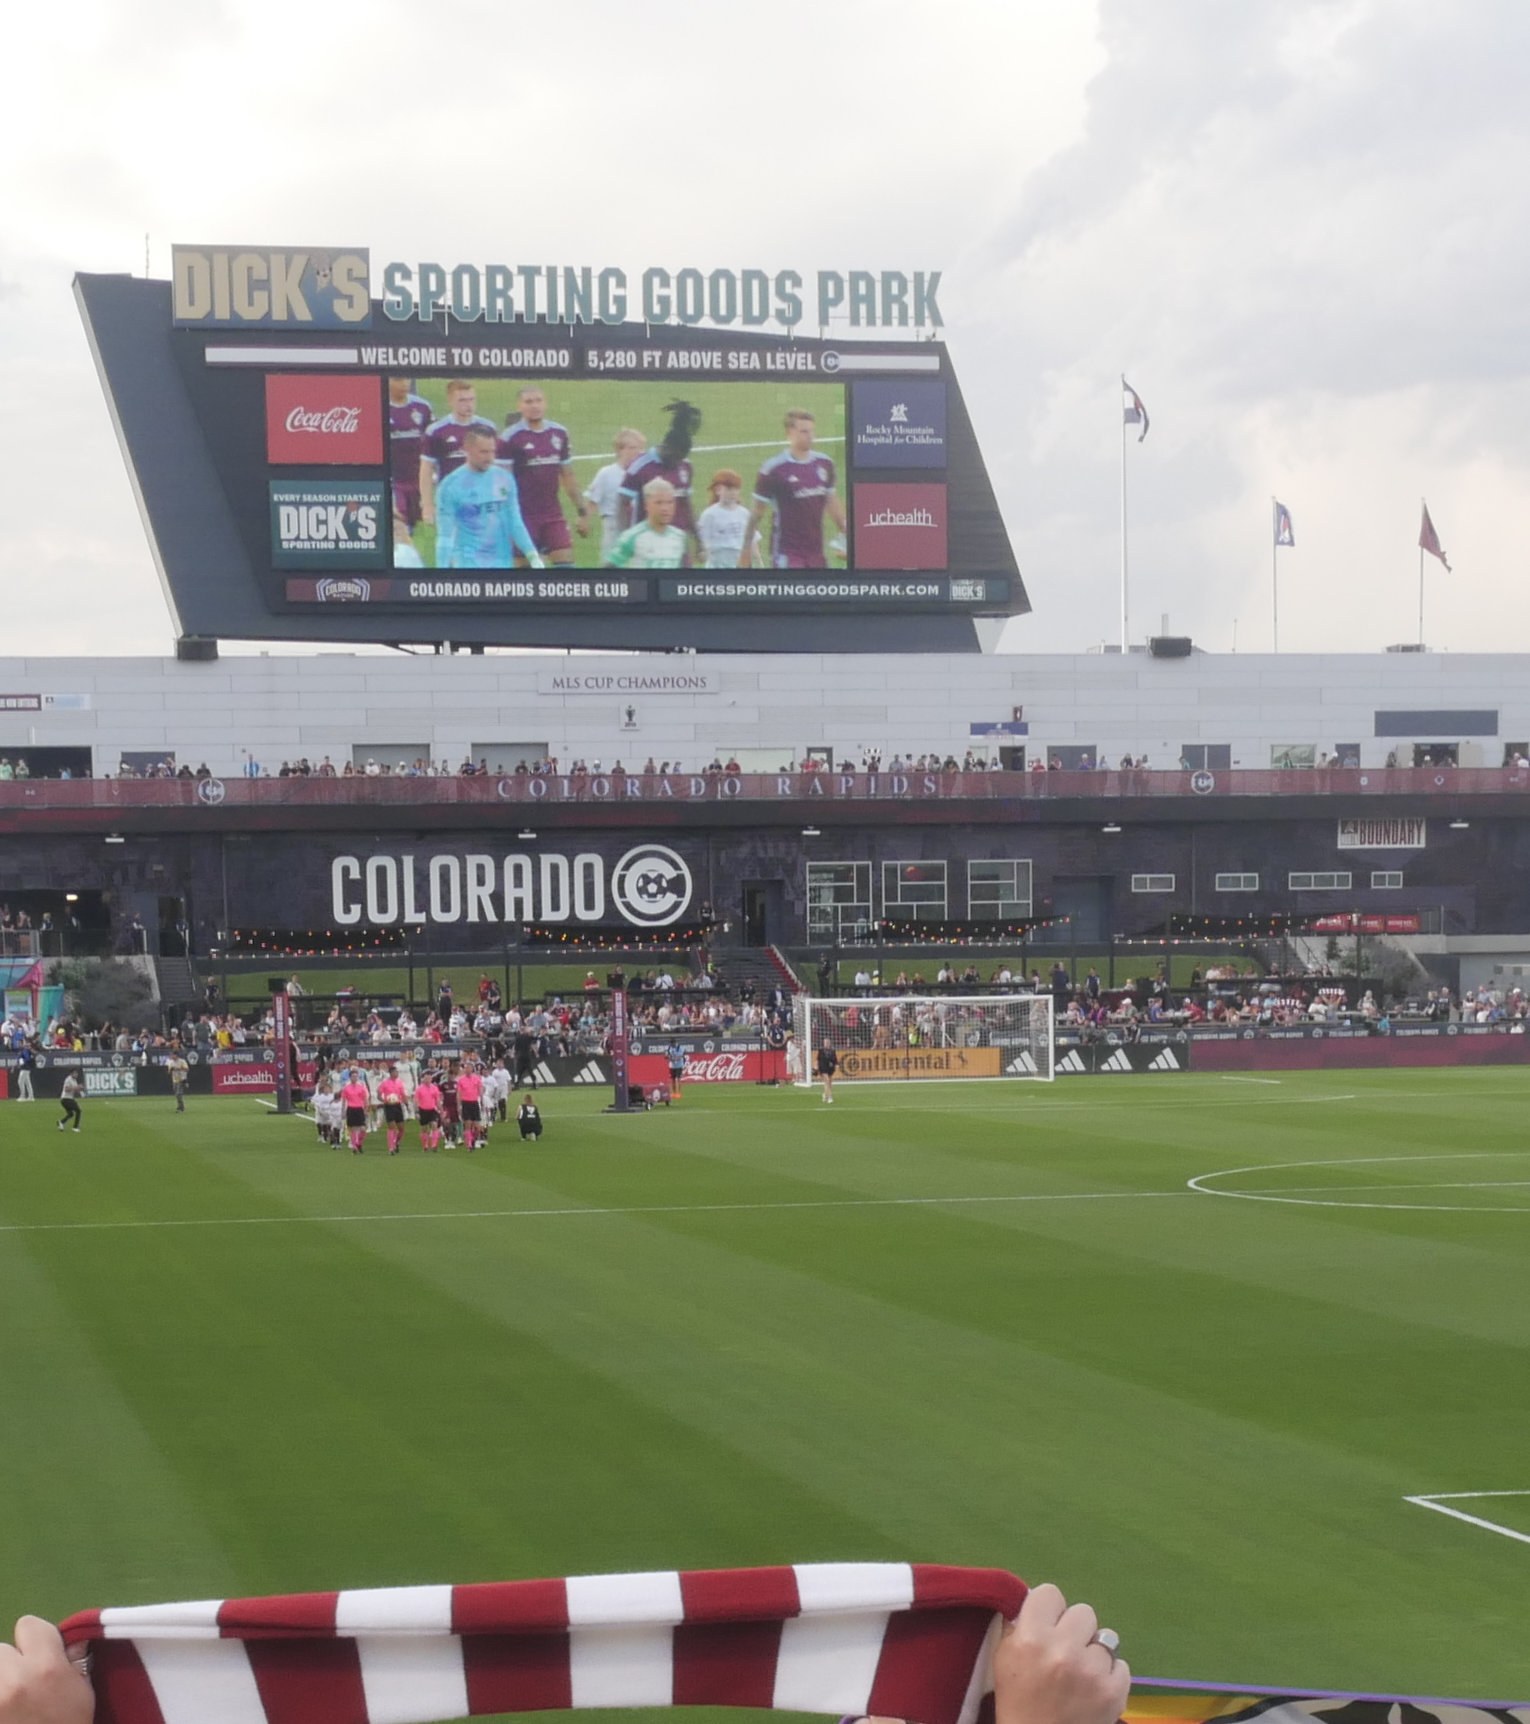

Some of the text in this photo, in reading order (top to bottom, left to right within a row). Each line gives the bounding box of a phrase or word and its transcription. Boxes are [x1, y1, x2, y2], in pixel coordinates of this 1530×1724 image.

[174, 252, 944, 327] DICK'S SPORTING GOODS PARK
[361, 347, 570, 367] WELCOME TO COLORADO
[588, 350, 816, 370] 5,280 FT ABOVE SEA LEVEL
[286, 406, 362, 433] Coca-Cola
[866, 425, 934, 436] Rocky Mountain
[858, 435, 892, 446] Hospital
[906, 435, 943, 444] Children
[273, 494, 381, 502] EVERY SEASON STARTS AT
[279, 505, 377, 540] DICK'S
[869, 508, 932, 525] uchealth
[282, 541, 376, 549] SPORTING GOODS
[410, 583, 629, 597] COLORADO RAPIDS SOCCER CLUB
[677, 584, 939, 596] DICKSSPORTINGGOODSPARK.COM
[552, 677, 707, 690] MLS CUP CHAMPIONS
[498, 775, 937, 798] COLORADO RAPIDS
[1359, 819, 1423, 846] BOUNDARY
[331, 852, 605, 926] COLORADO
[85, 1072, 135, 1090] DICK'S
[222, 1070, 273, 1087] uchealth
